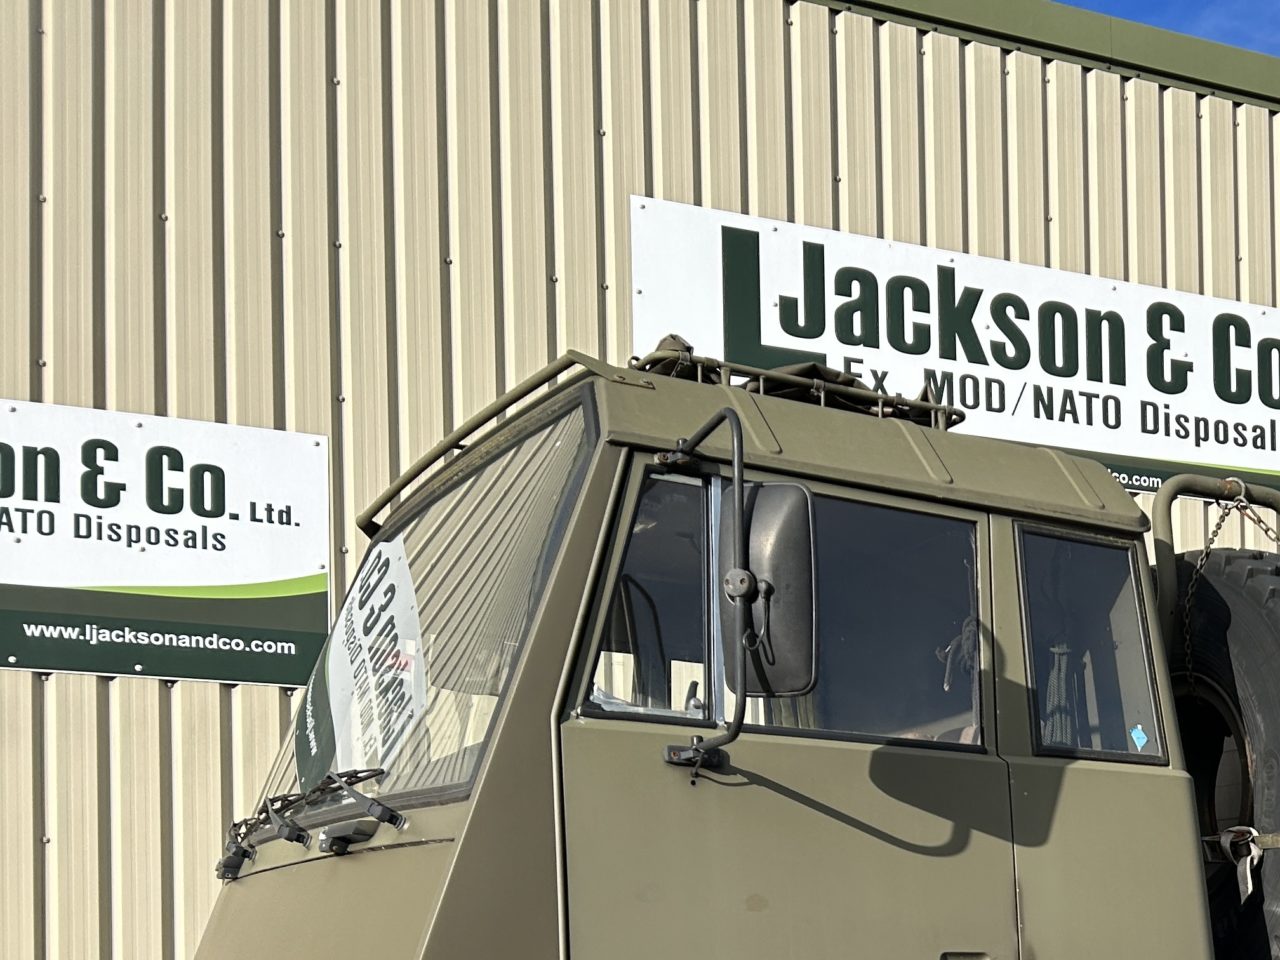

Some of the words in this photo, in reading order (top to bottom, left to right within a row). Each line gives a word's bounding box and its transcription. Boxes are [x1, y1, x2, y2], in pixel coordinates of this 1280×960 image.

[1146, 301, 1194, 395] &
[80, 438, 126, 509] &
[145, 445, 240, 521] Co.
[250, 501, 301, 527] Ltd.
[73, 512, 226, 552] Disposals
[22, 620, 296, 657] www.ljacksonandco.com
